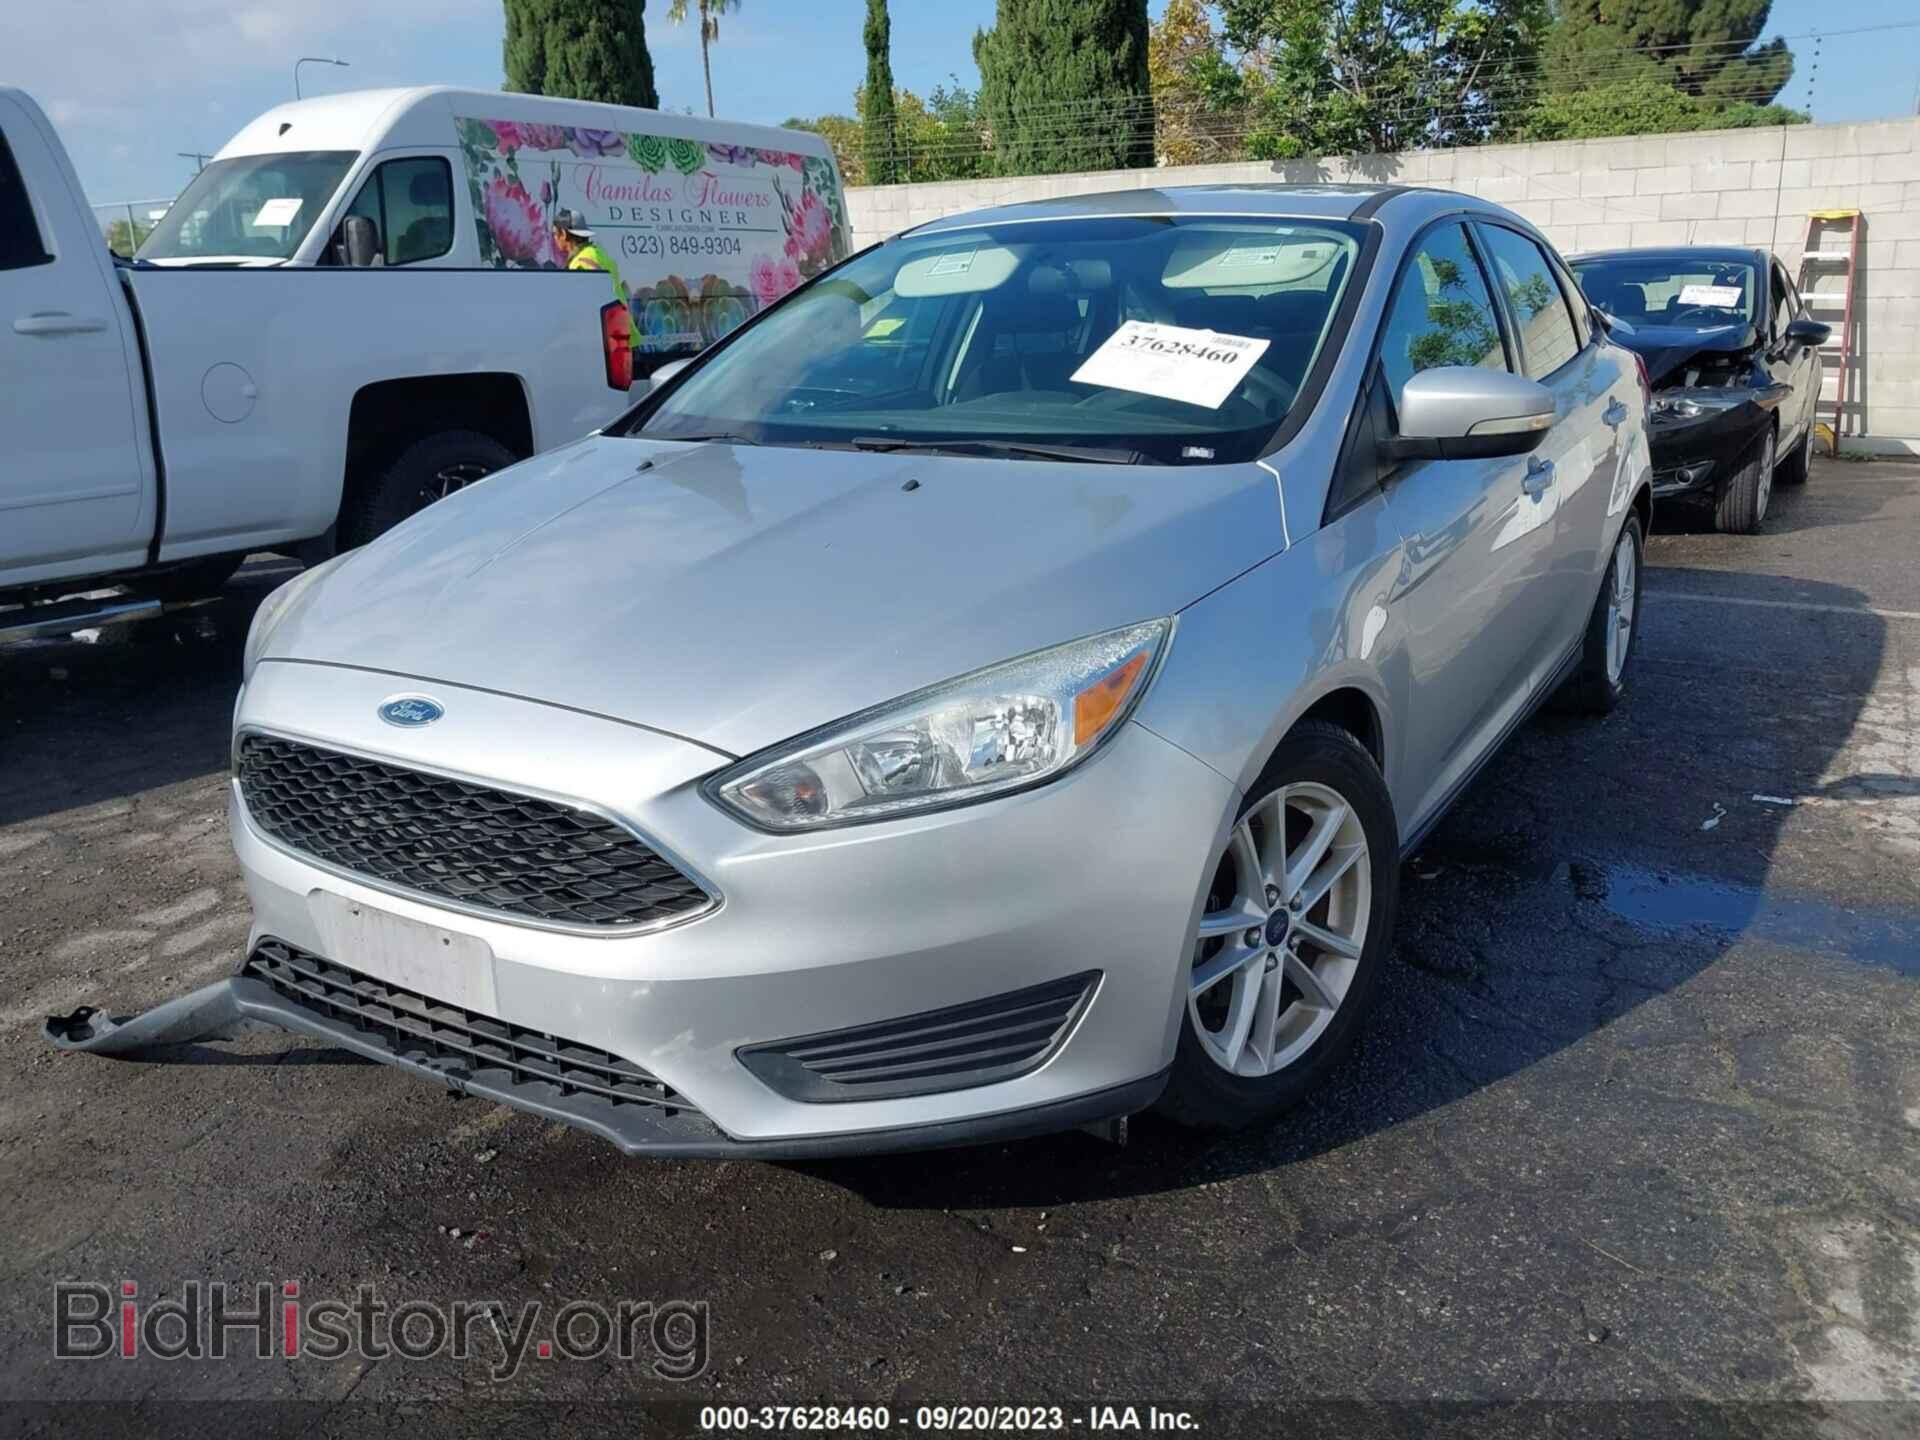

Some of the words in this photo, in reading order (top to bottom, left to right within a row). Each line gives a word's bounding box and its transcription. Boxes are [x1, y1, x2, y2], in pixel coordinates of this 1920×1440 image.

[574, 164, 673, 206] Camilas
[684, 171, 770, 208] Flowers
[608, 206, 749, 225] DESIGNER
[620, 235, 665, 259] (323)
[669, 236, 742, 256] 849-9304
[1120, 335, 1239, 365] 37628460
[390, 700, 432, 721] Ford
